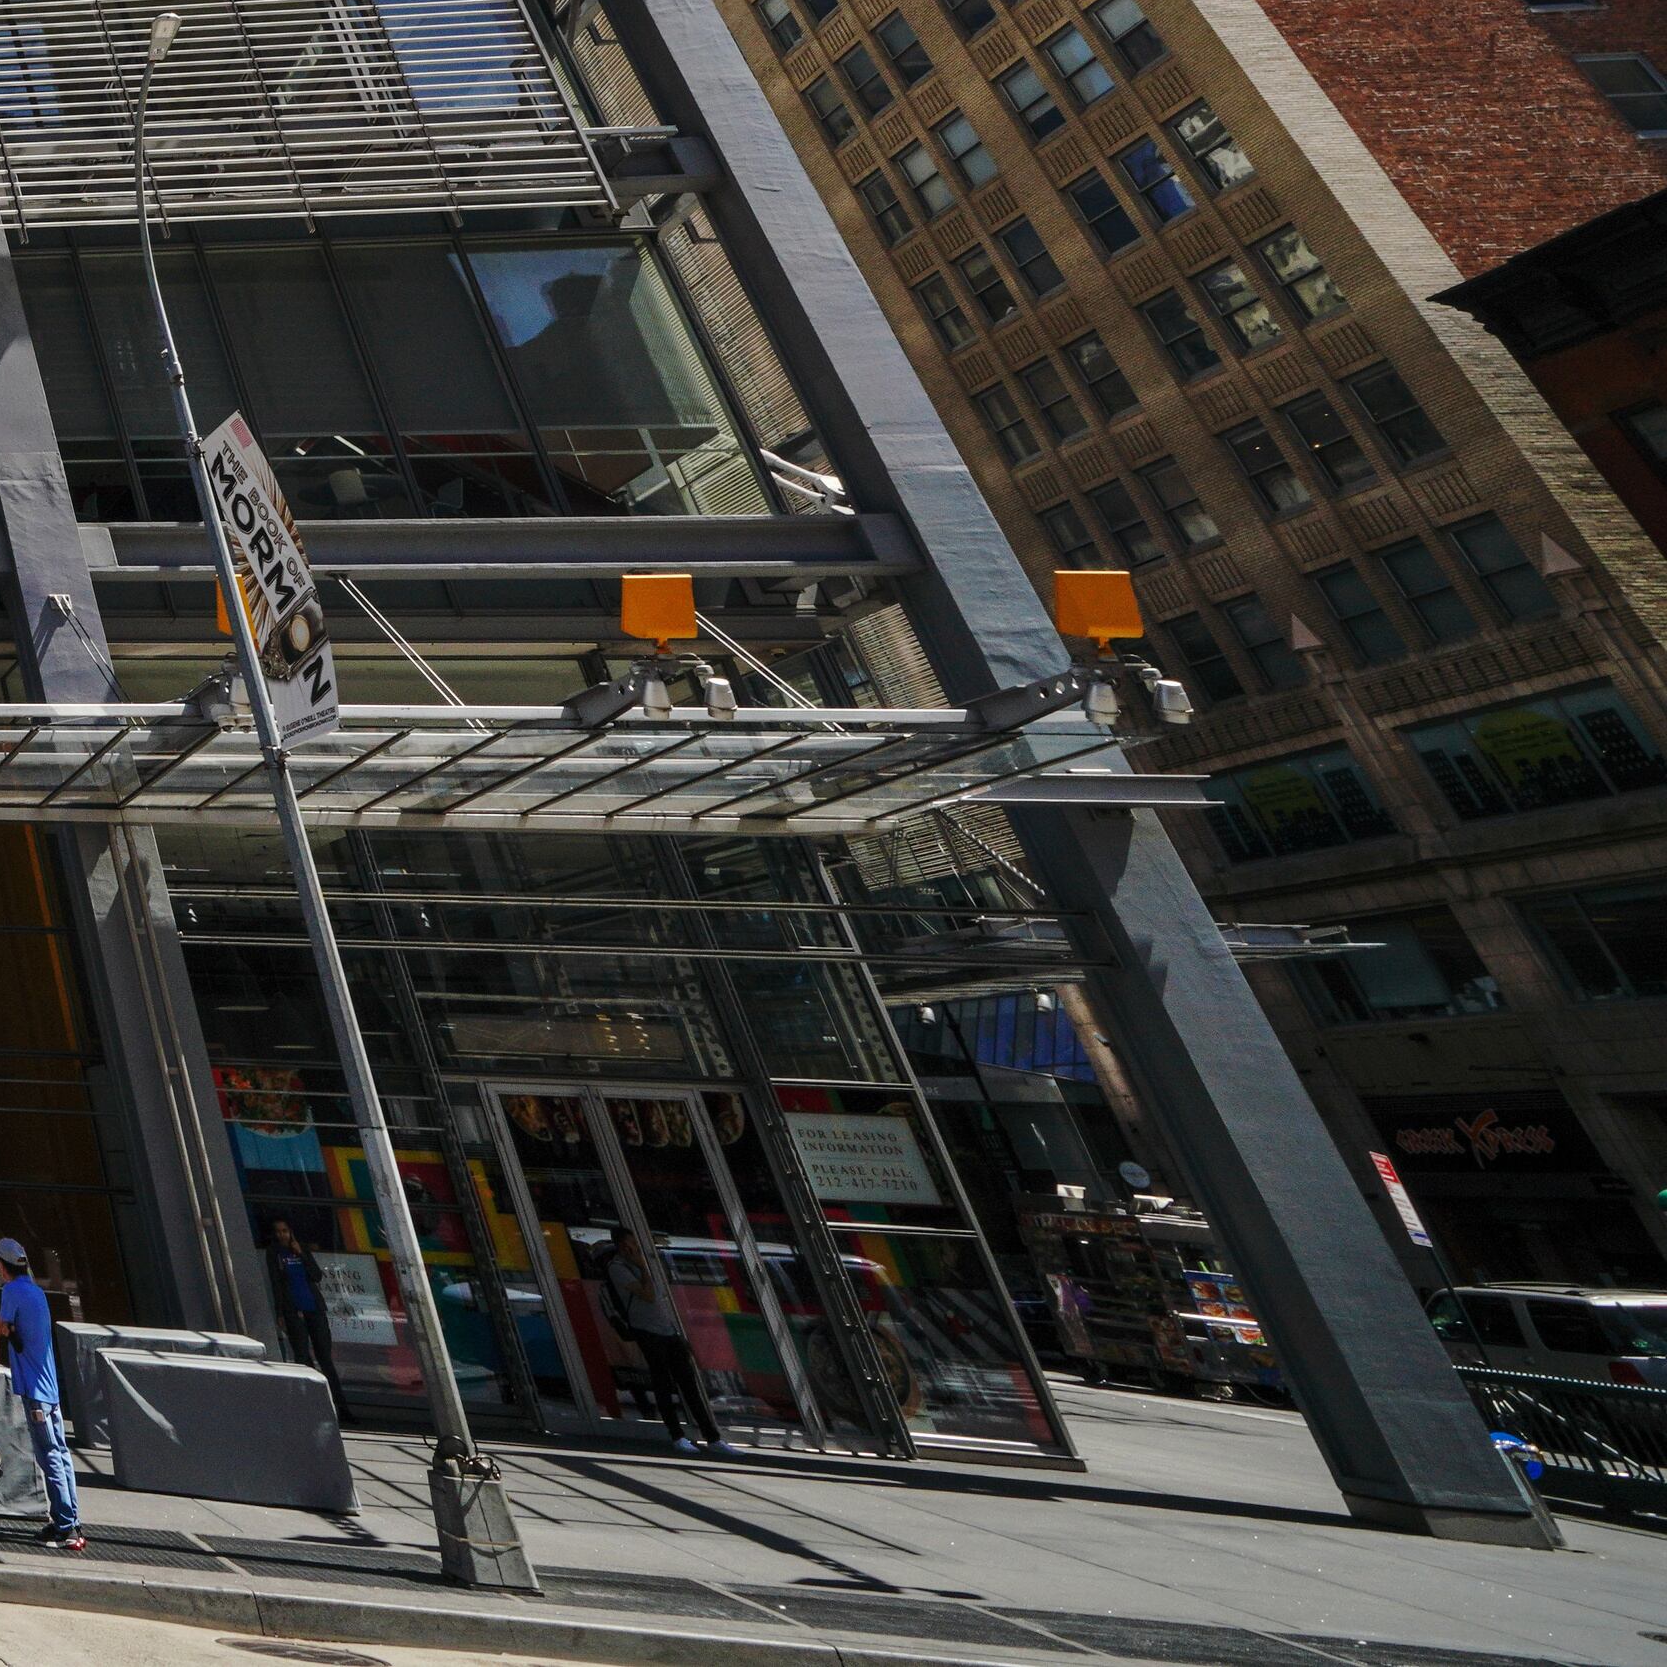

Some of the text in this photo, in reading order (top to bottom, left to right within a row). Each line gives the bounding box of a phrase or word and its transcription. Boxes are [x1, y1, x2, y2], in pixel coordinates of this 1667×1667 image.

[221, 439, 306, 588] THE BOOK OF
[797, 1128, 899, 1142] FOR LEASING
[802, 1141, 903, 1156] INFORMATION
[811, 1164, 914, 1179] PLEASE CALL:
[816, 1176, 918, 1191] 212-417-7210
